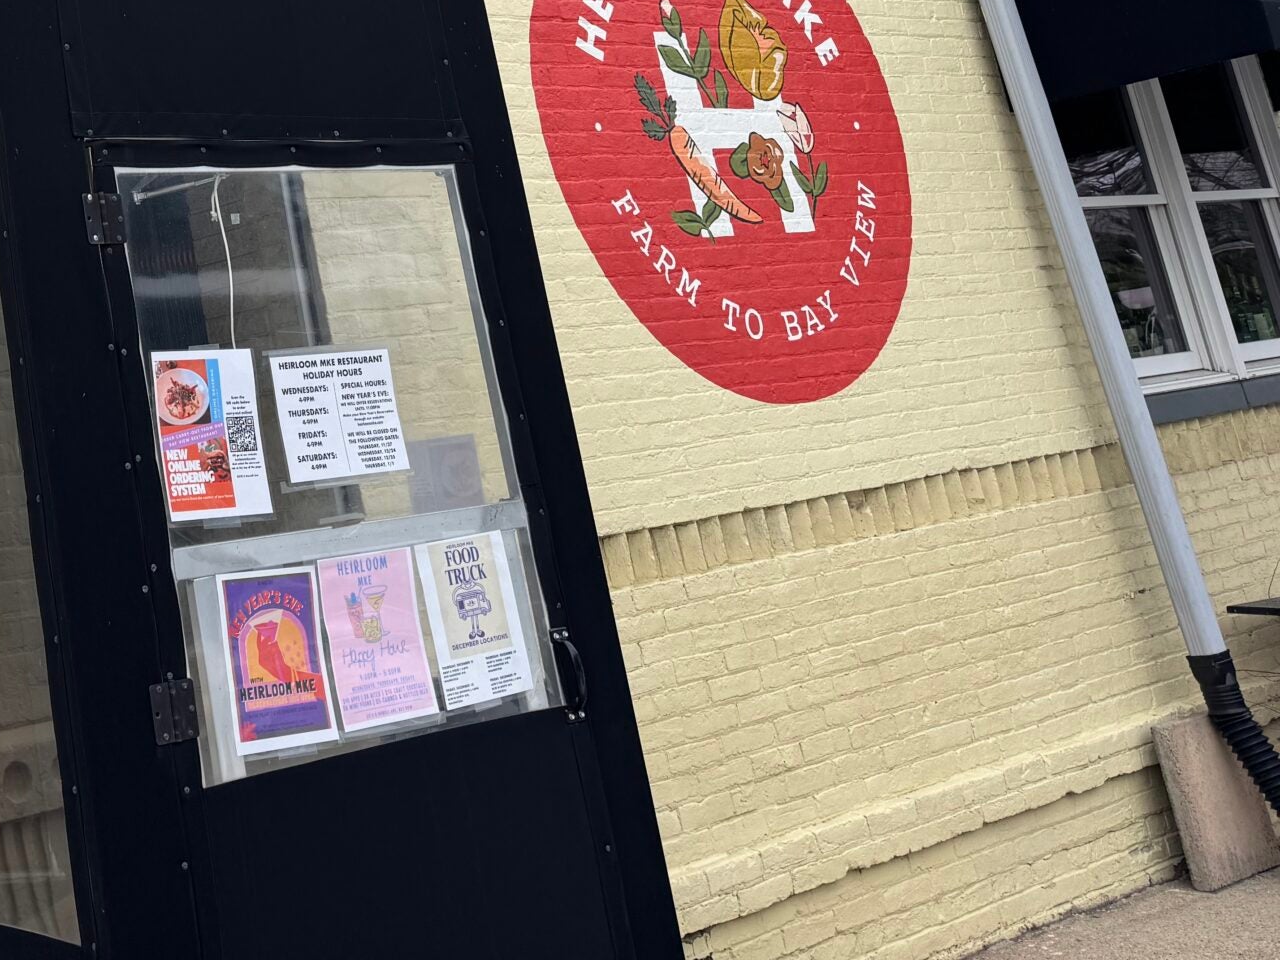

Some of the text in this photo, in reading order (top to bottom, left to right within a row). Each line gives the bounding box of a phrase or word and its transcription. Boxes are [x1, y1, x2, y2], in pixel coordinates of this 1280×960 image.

[611, 182, 876, 342] FARM TO BAY VIEW
[278, 354, 383, 370] HEIRLOOM MKE RESTAURANT
[302, 368, 362, 379] HOLIDAY HOURS
[281, 385, 328, 395] WEDNESDAYS:
[340, 381, 363, 389] SPECIAL
[288, 407, 329, 417] THURSDAYS:
[298, 430, 327, 439] FRIDAYS:
[166, 448, 188, 459] NEW
[297, 452, 337, 462] SATURDAYS:
[167, 459, 201, 472] ONLINE
[169, 470, 215, 485] ORDERING
[170, 482, 206, 497] SYSTEM
[444, 546, 480, 567] FOOD
[336, 555, 388, 576] HEIRLOOM
[357, 575, 372, 586] MKE
[445, 563, 487, 586] TRUCK
[244, 590, 281, 615] YEAR'S
[452, 633, 508, 651] DECEMBER LOCATIONS
[250, 676, 263, 684] WITH
[239, 682, 293, 701] HEIRLOOM
[295, 678, 316, 693] MKE
